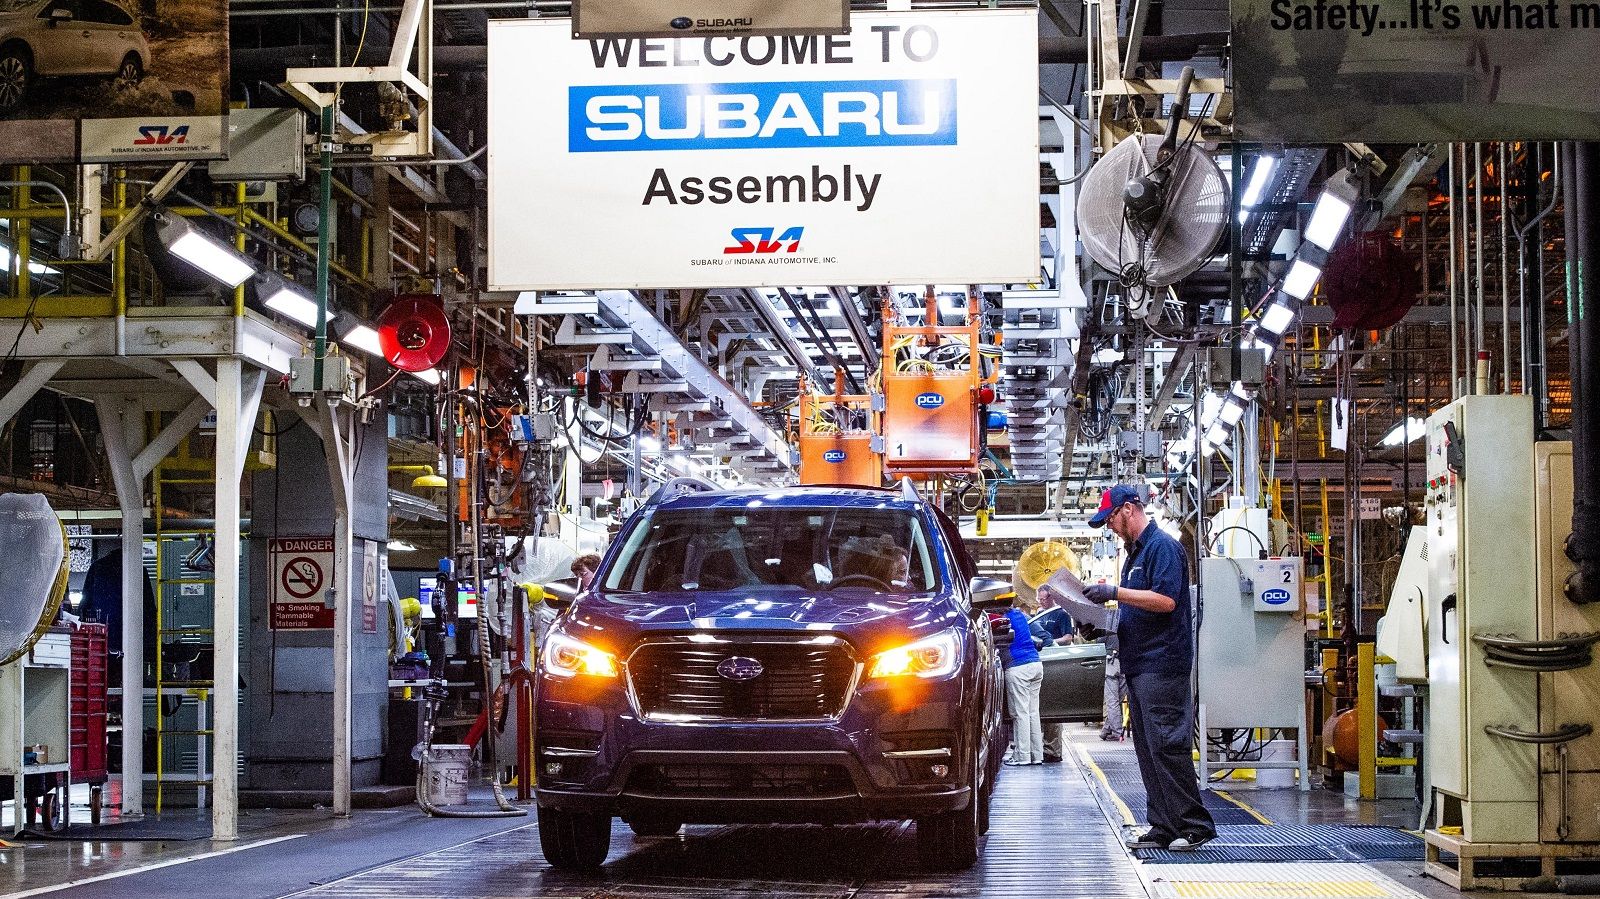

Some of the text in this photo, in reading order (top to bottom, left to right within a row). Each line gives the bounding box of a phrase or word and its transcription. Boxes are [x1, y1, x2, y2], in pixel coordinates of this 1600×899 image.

[1471, 0, 1559, 29] what
[696, 18, 753, 27] SUBARU
[589, 25, 940, 68] WELCOME TO
[585, 89, 942, 142] SUBARU
[642, 165, 883, 212] Assembly
[767, 257, 821, 265] AUTOMOTIVE,
[896, 443, 903, 456] 1
[285, 541, 333, 551] DANGER
[1283, 570, 1291, 583] 2
[1264, 592, 1288, 602] pcu
[288, 604, 320, 612] Smoking
